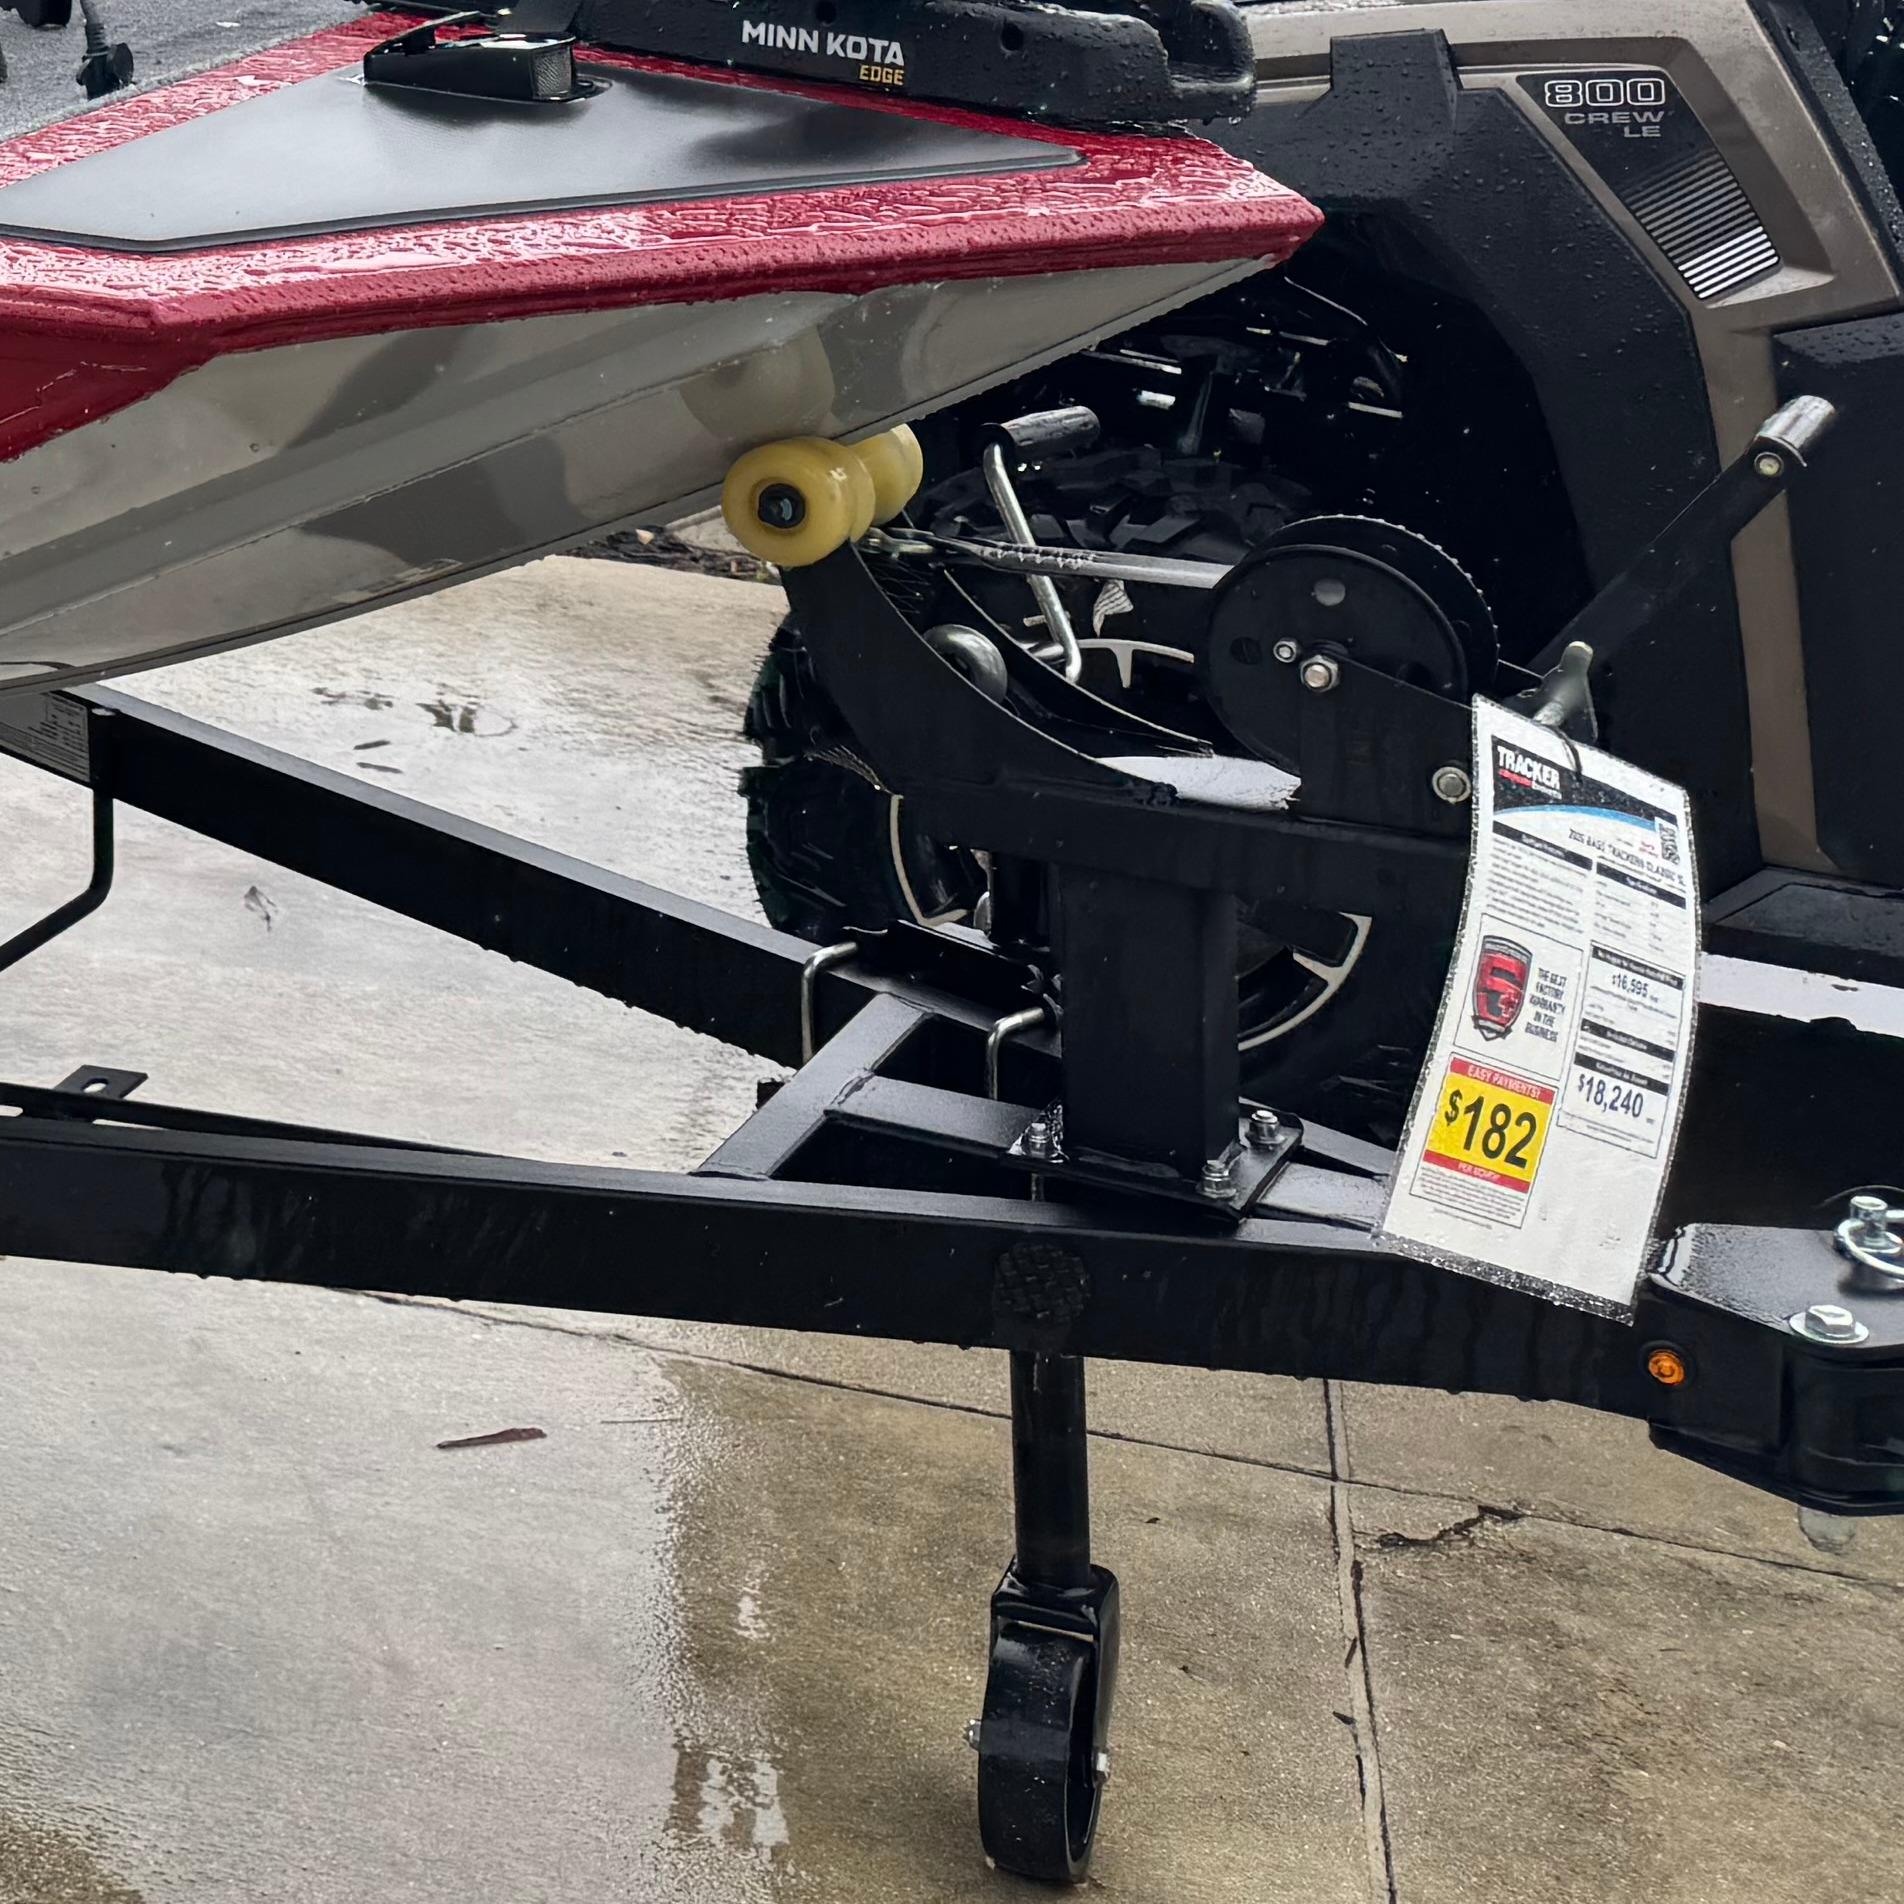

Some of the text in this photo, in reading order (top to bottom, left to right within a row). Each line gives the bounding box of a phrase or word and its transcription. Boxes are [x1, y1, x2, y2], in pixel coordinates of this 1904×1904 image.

[741, 19, 905, 67] MINN KOTA
[859, 63, 905, 86] EDGE
[1544, 77, 1666, 108] 800
[1564, 110, 1666, 125] CREW
[1623, 125, 1662, 138] LE
[1497, 745, 1562, 791] TRACKER
[1467, 1064, 1492, 1081] EASY
[1578, 1073, 1644, 1118] $18,240
[1444, 1088, 1537, 1170] $182
